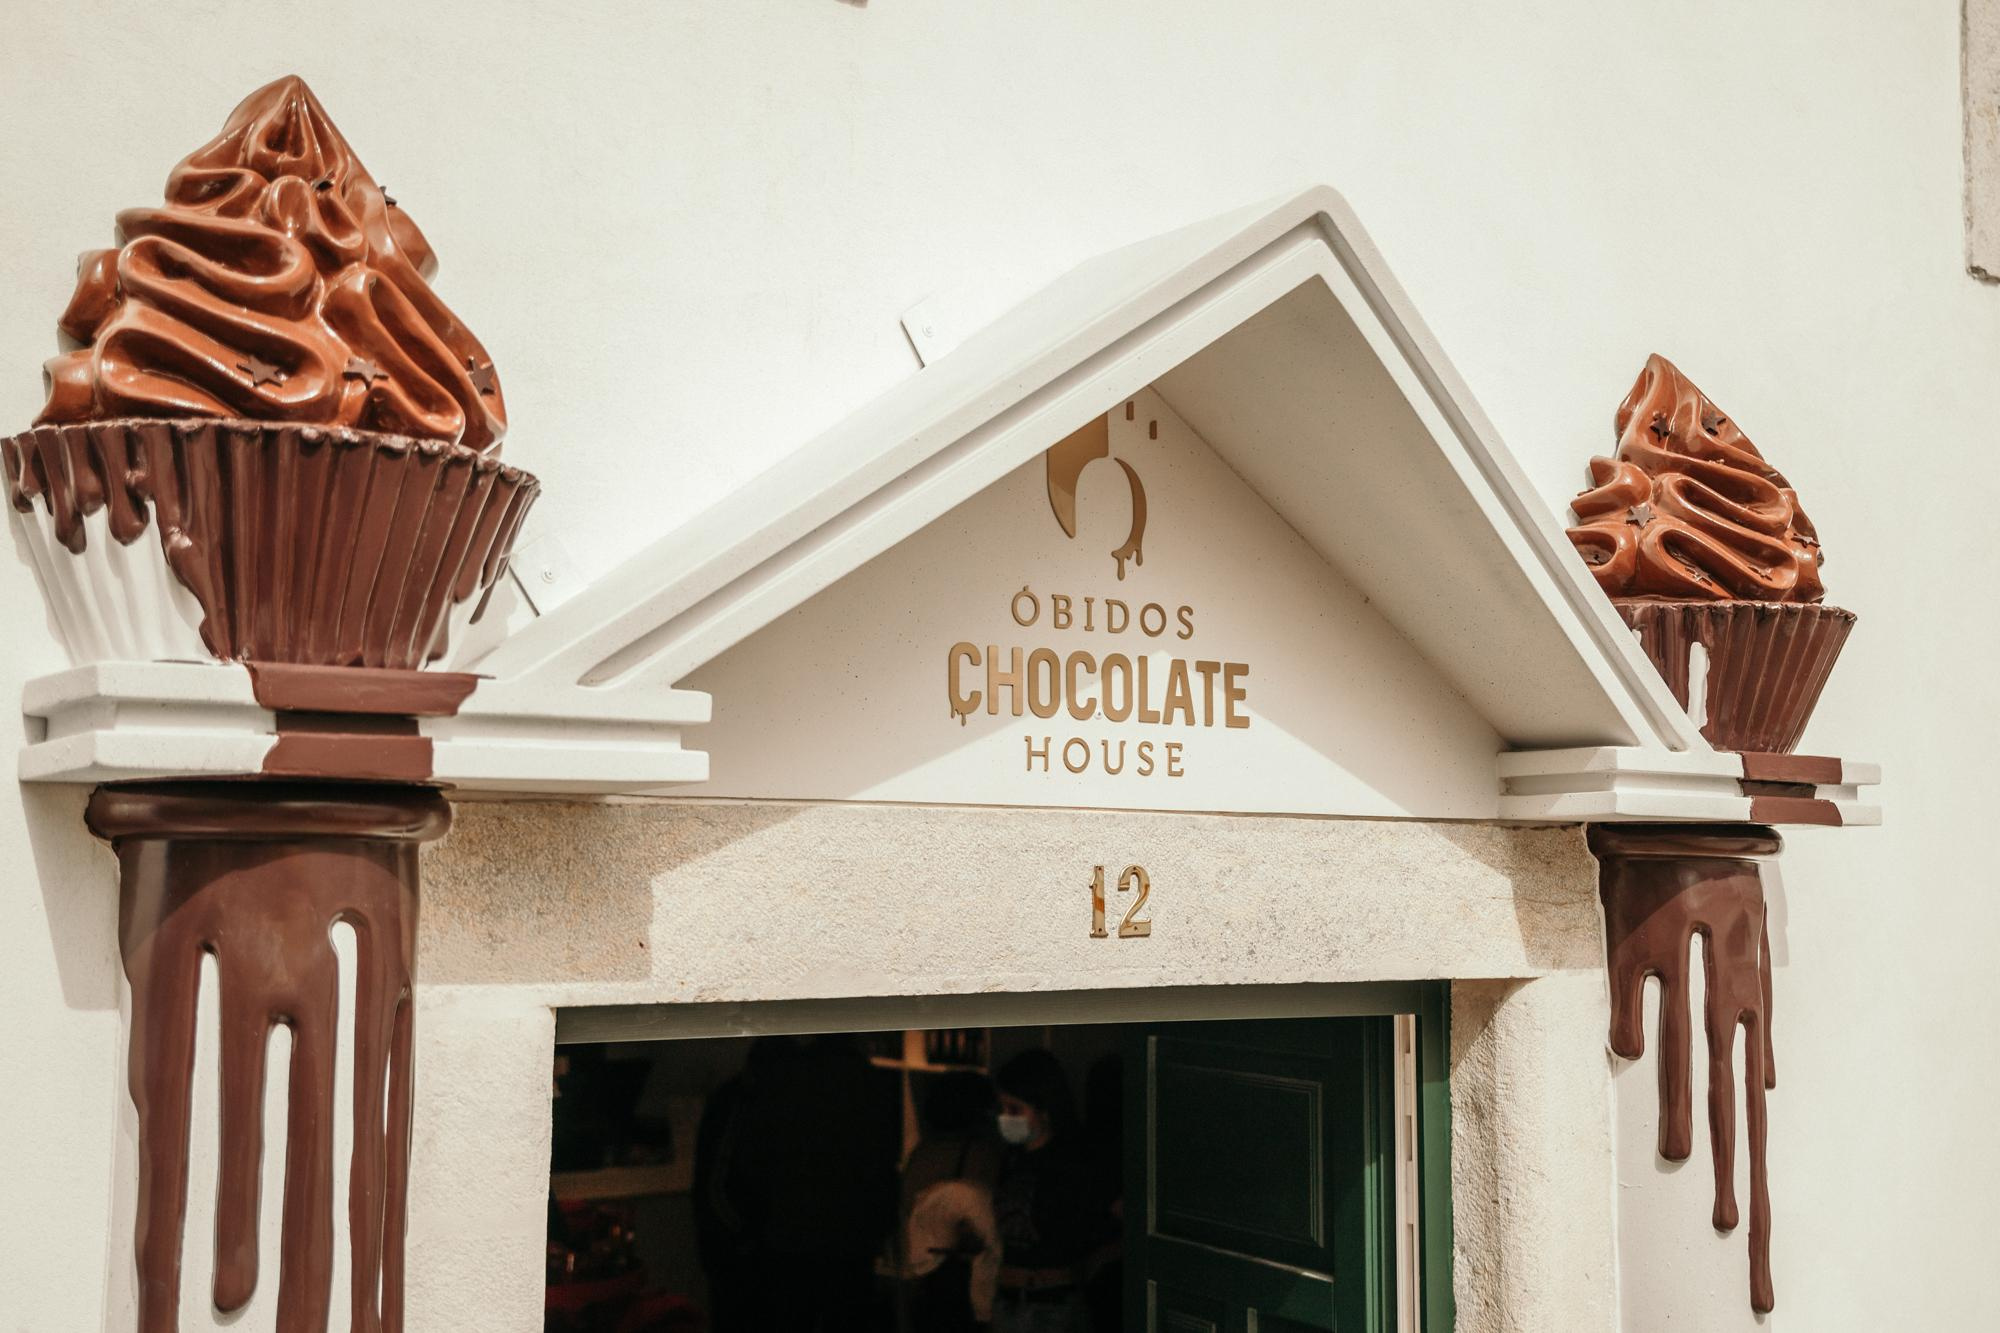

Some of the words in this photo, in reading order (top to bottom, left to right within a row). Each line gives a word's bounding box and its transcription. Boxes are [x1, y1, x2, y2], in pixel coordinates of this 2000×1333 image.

[1011, 585, 1195, 640] ÓBIDOS
[948, 642, 1251, 729] CHOCOLATE
[1024, 735, 1185, 777] HOUSE
[1089, 864, 1152, 939] 12
